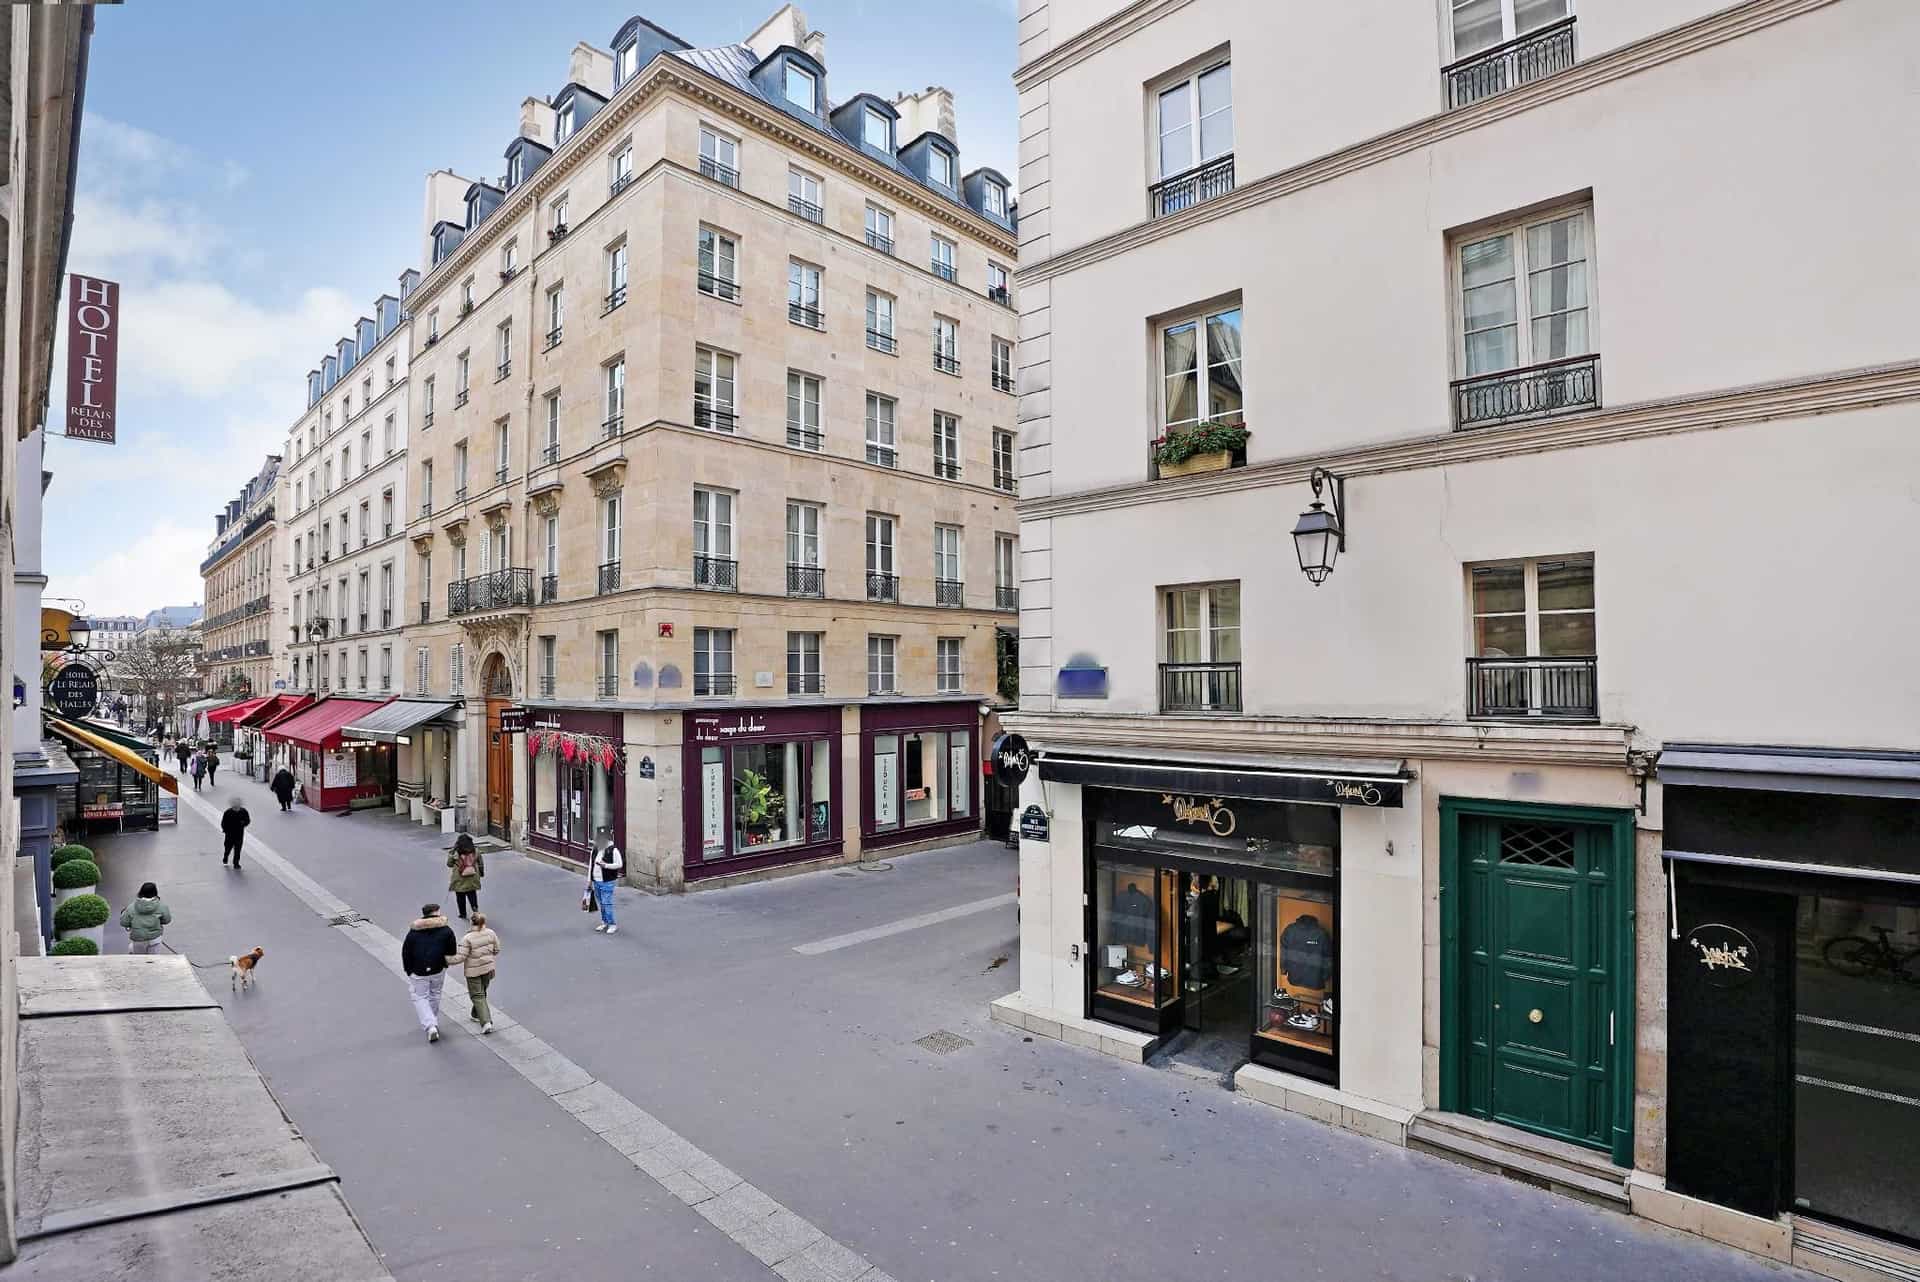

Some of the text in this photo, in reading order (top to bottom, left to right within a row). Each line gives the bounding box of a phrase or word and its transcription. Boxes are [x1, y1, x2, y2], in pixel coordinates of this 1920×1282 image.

[78, 278, 112, 408] HOTEL
[71, 406, 112, 420] RELAIS
[80, 417, 103, 428] DES
[68, 426, 113, 440] HALLES
[60, 700, 91, 708] HALLES
